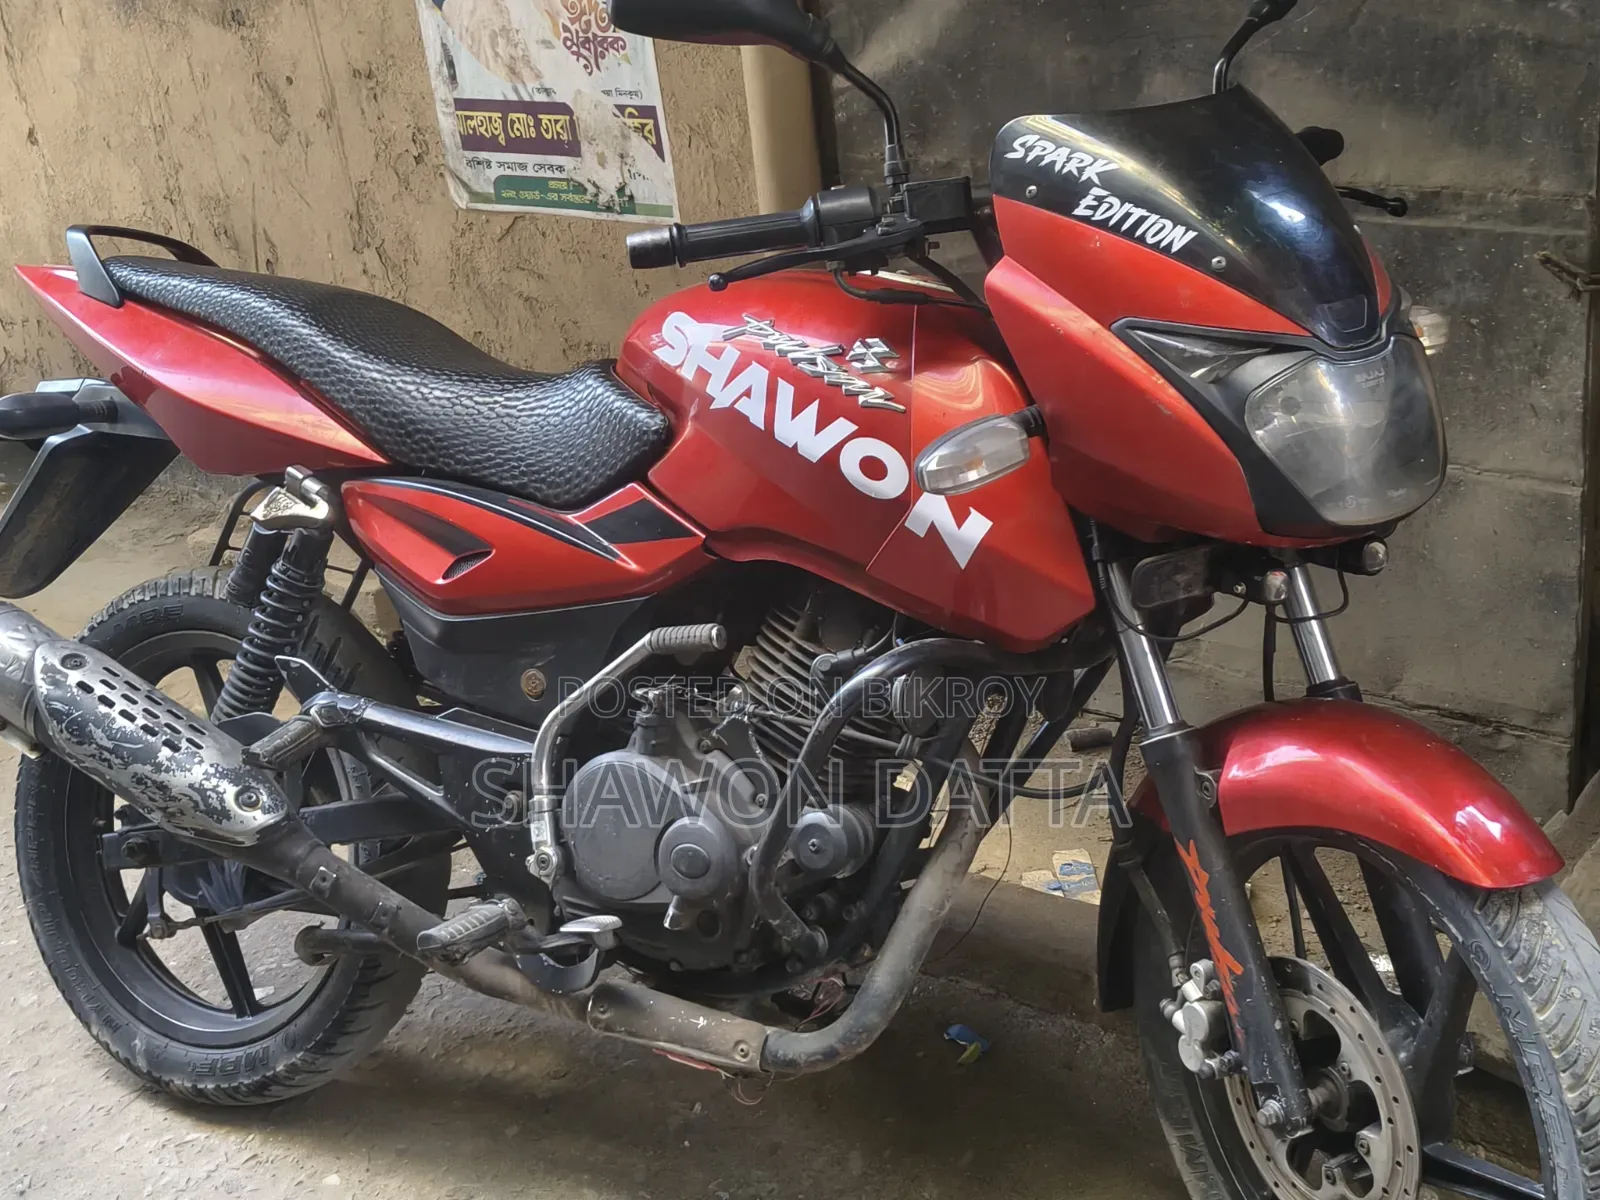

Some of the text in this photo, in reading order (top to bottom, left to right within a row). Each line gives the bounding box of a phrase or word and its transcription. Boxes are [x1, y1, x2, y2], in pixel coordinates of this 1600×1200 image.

[1004, 134, 1120, 184] SPARK
[1072, 187, 1198, 253] EDITION
[652, 311, 993, 570] SHAWON
